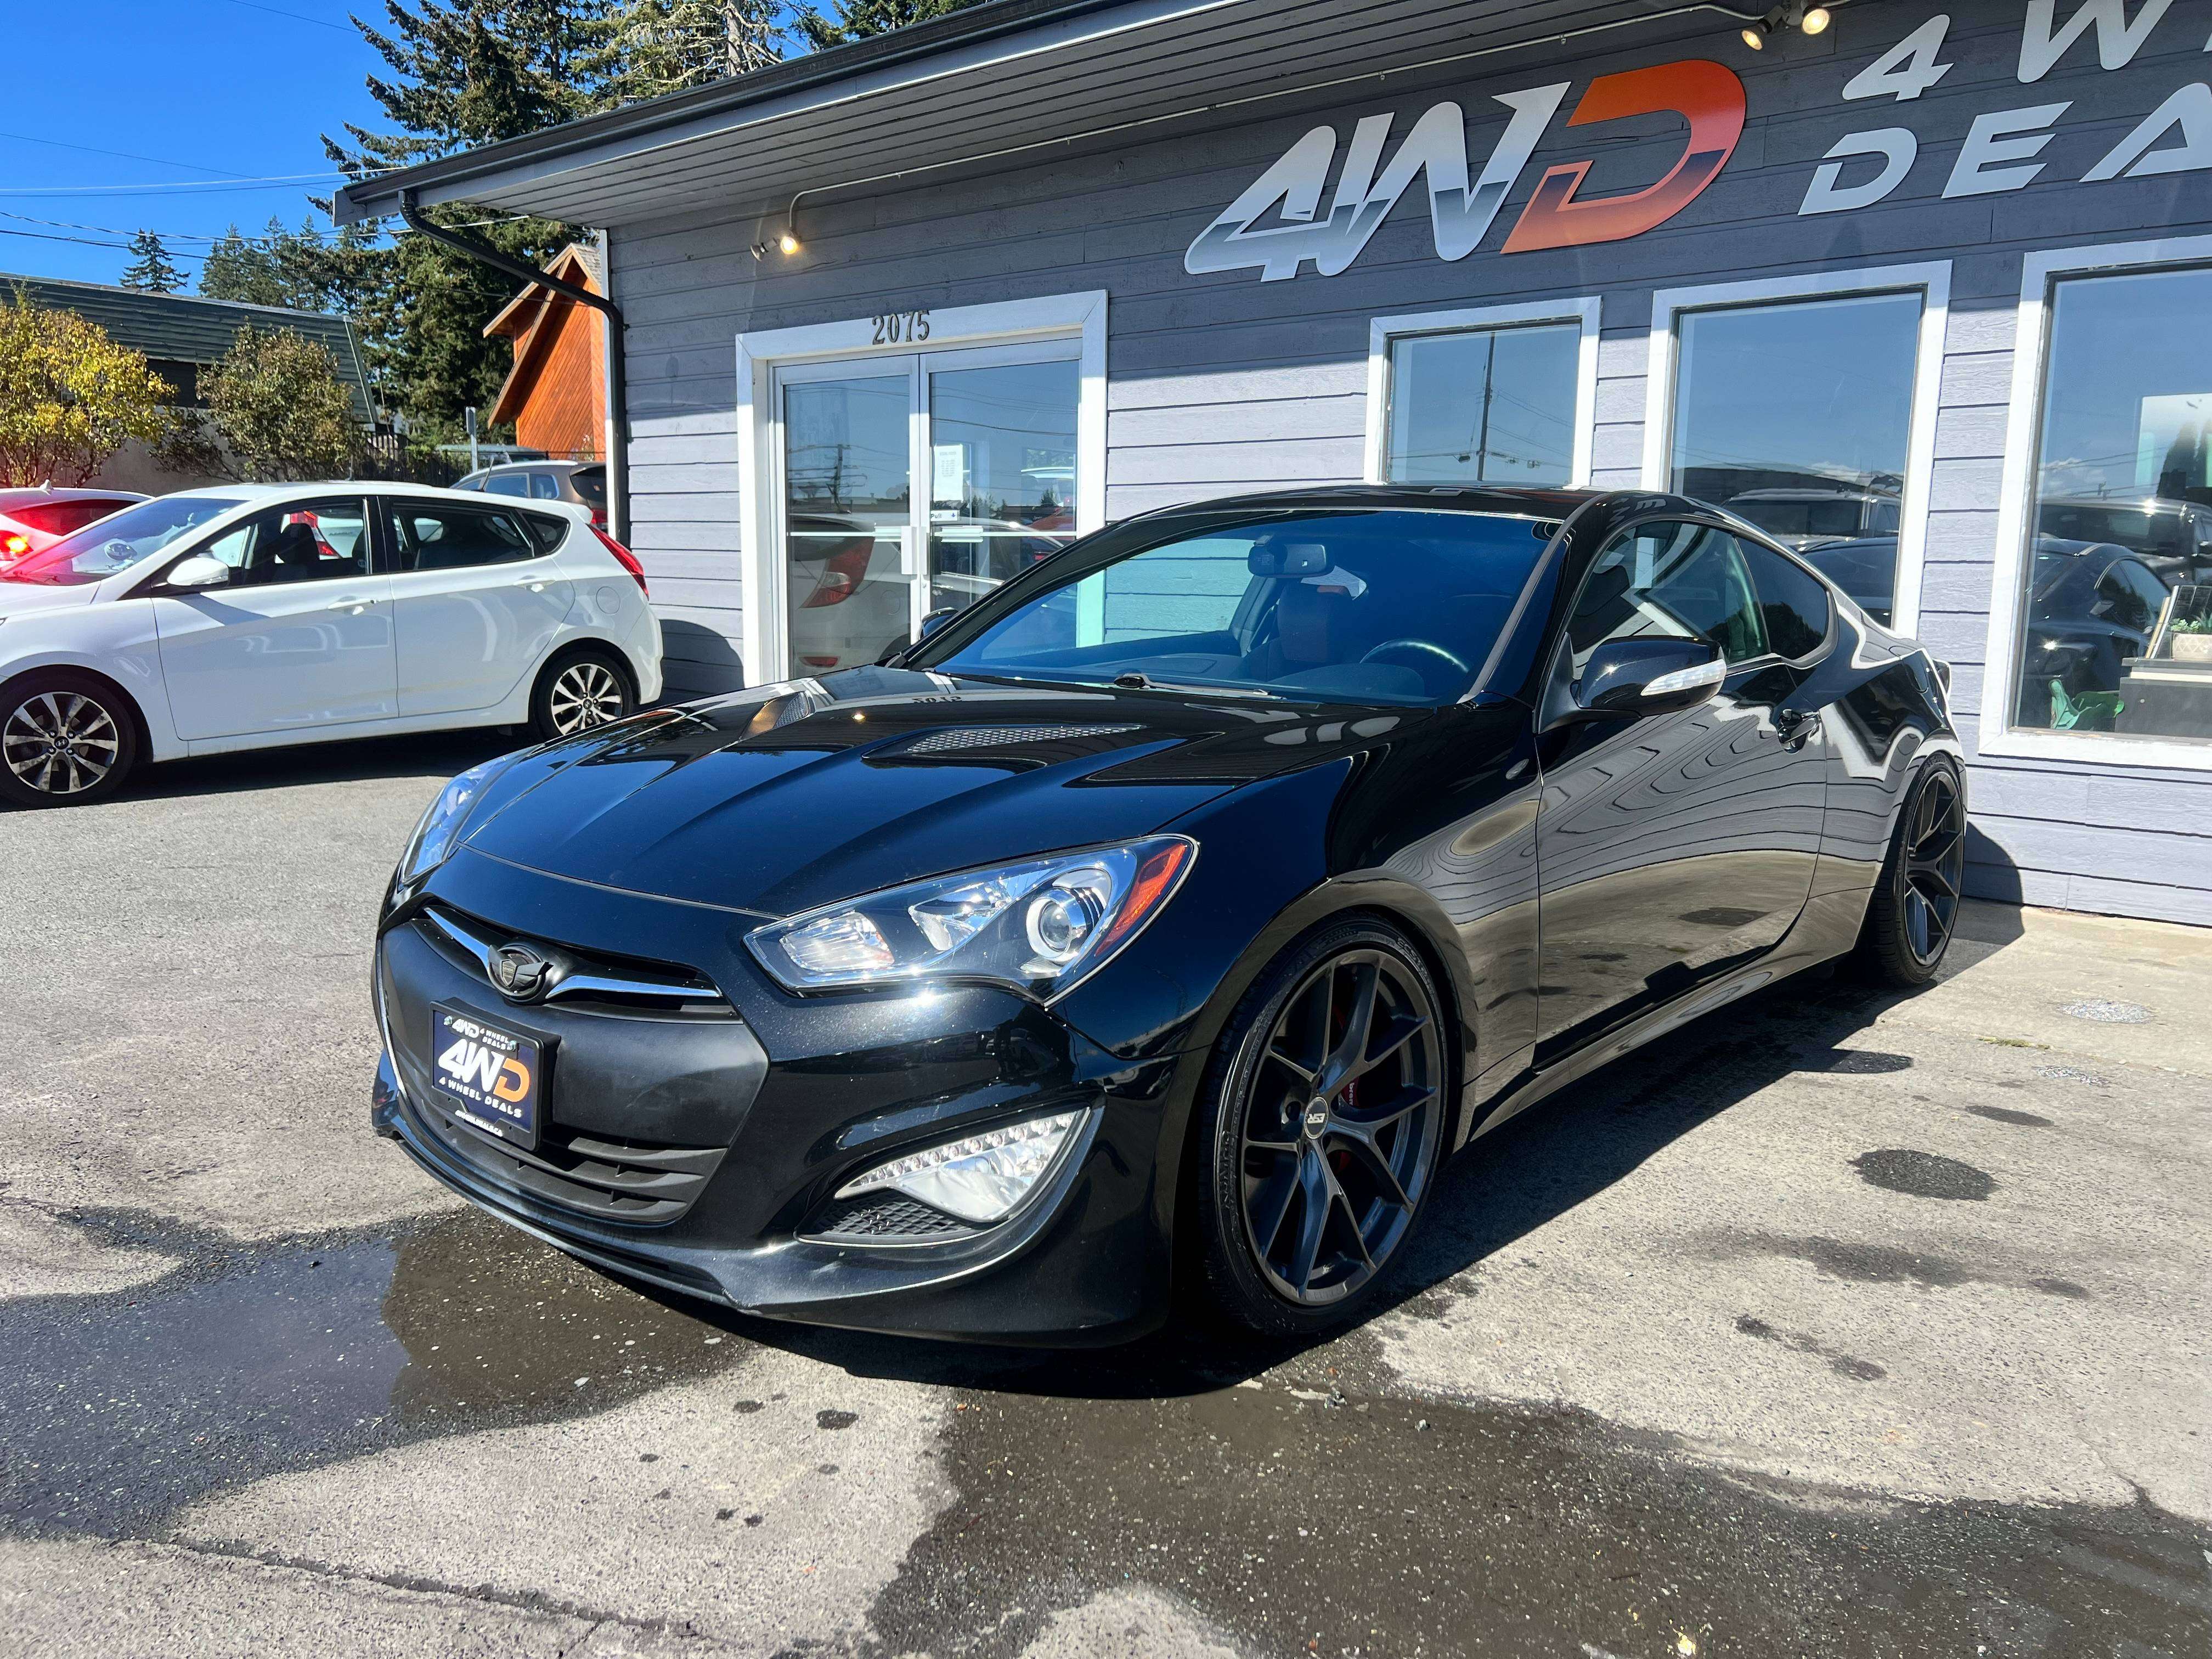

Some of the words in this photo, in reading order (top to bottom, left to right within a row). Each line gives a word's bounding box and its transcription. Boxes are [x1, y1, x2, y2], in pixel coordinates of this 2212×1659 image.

[1842, 14, 1954, 101] 4
[2017, 0, 2212, 83] W
[1184, 59, 1747, 283] 4WD
[1797, 82, 2212, 216] DEA
[872, 310, 930, 345] 2075
[452, 1018, 479, 1038] 4WD
[438, 1038, 531, 1103] 4WD
[439, 1076, 446, 1086] 4
[448, 1079, 482, 1101] WHEEL
[484, 1096, 522, 1118] DEALS
